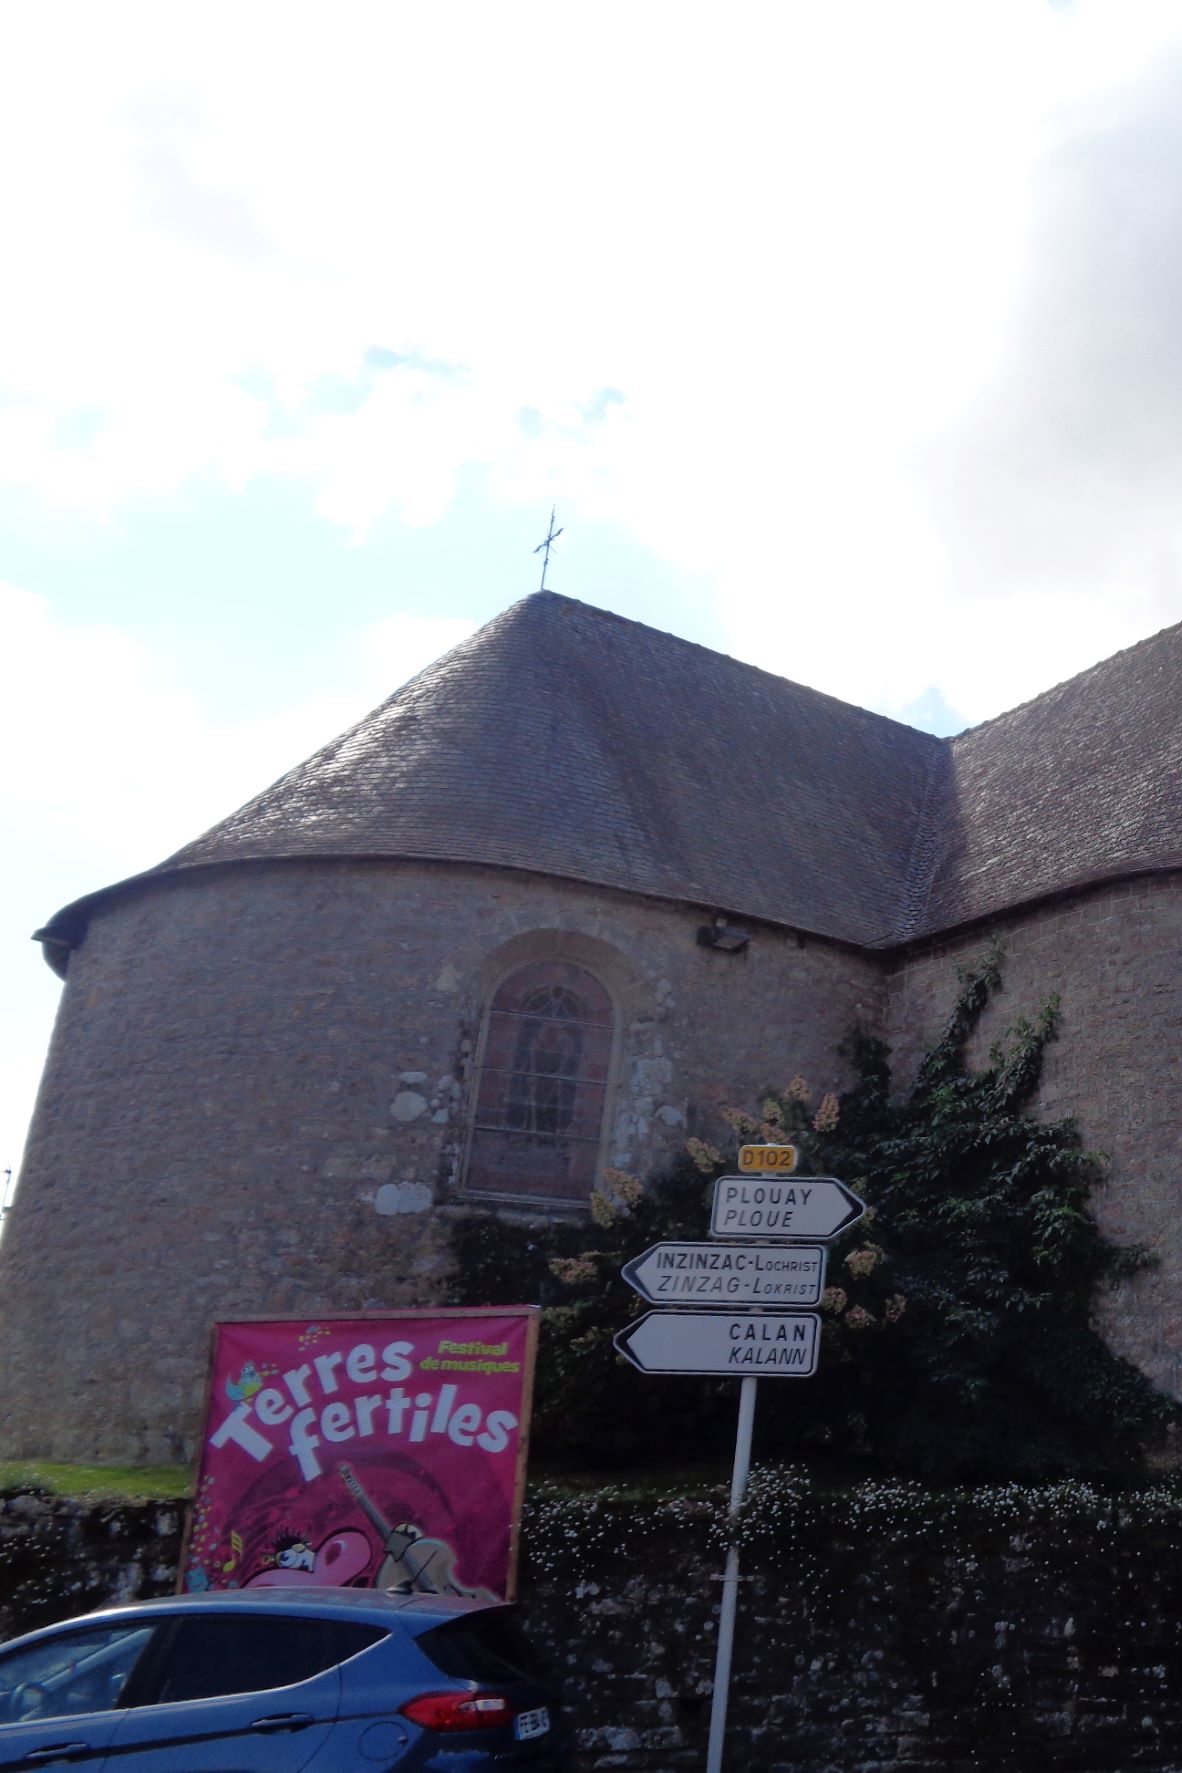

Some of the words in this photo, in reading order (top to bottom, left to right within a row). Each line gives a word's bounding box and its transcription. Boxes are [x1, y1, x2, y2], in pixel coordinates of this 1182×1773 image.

[742, 1151, 791, 1166] D102
[726, 1187, 813, 1206] PLOUAY
[723, 1210, 794, 1228] PLOUE
[729, 1323, 806, 1342] CALAN
[728, 1347, 807, 1366] KALANN
[209, 1340, 415, 1463] Terres
[288, 1383, 519, 1483] fertiles
